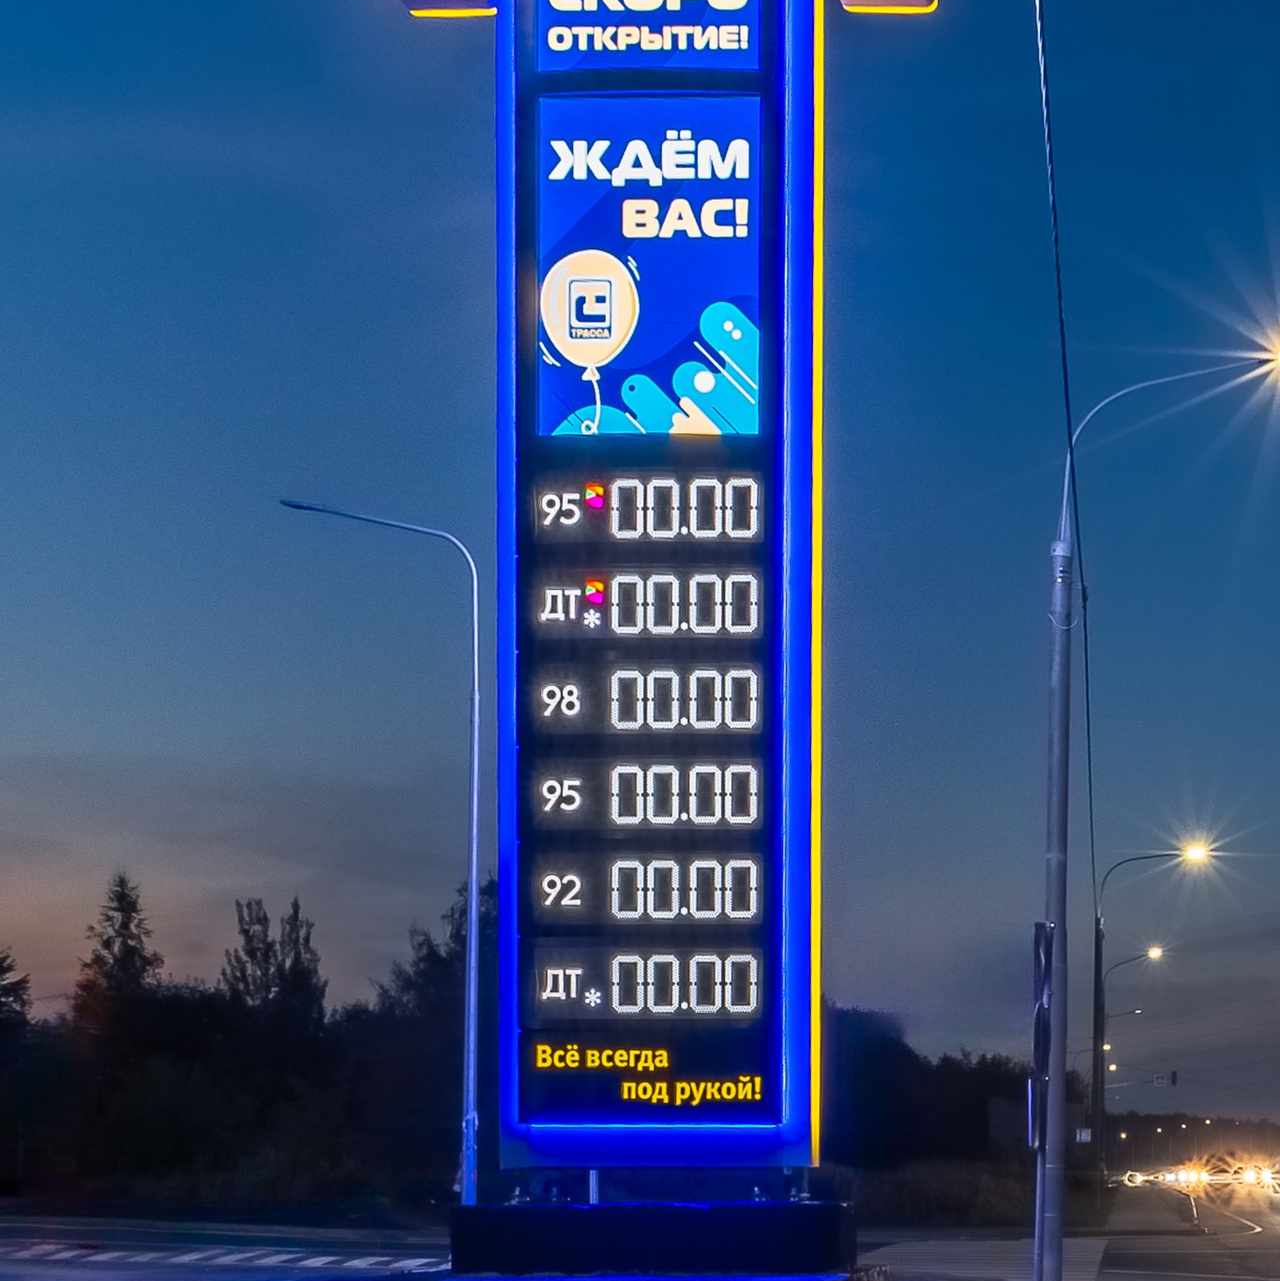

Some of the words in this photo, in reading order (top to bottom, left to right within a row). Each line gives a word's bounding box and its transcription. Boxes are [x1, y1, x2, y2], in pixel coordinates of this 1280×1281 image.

[547, 25, 750, 51] ОТКРЫТИЕ!
[548, 129, 750, 187] ЖДЁМ
[621, 198, 749, 238] ВАС!
[541, 493, 581, 526] 95
[540, 589, 581, 621] ДТ
[541, 685, 581, 716] 98
[541, 780, 582, 811] 95
[541, 874, 582, 906] 92
[541, 969, 582, 999] ДТ
[535, 1044, 579, 1067] Всё
[585, 1049, 669, 1071] всегда
[622, 1080, 669, 1103] под
[675, 1077, 762, 1105] рукой!
